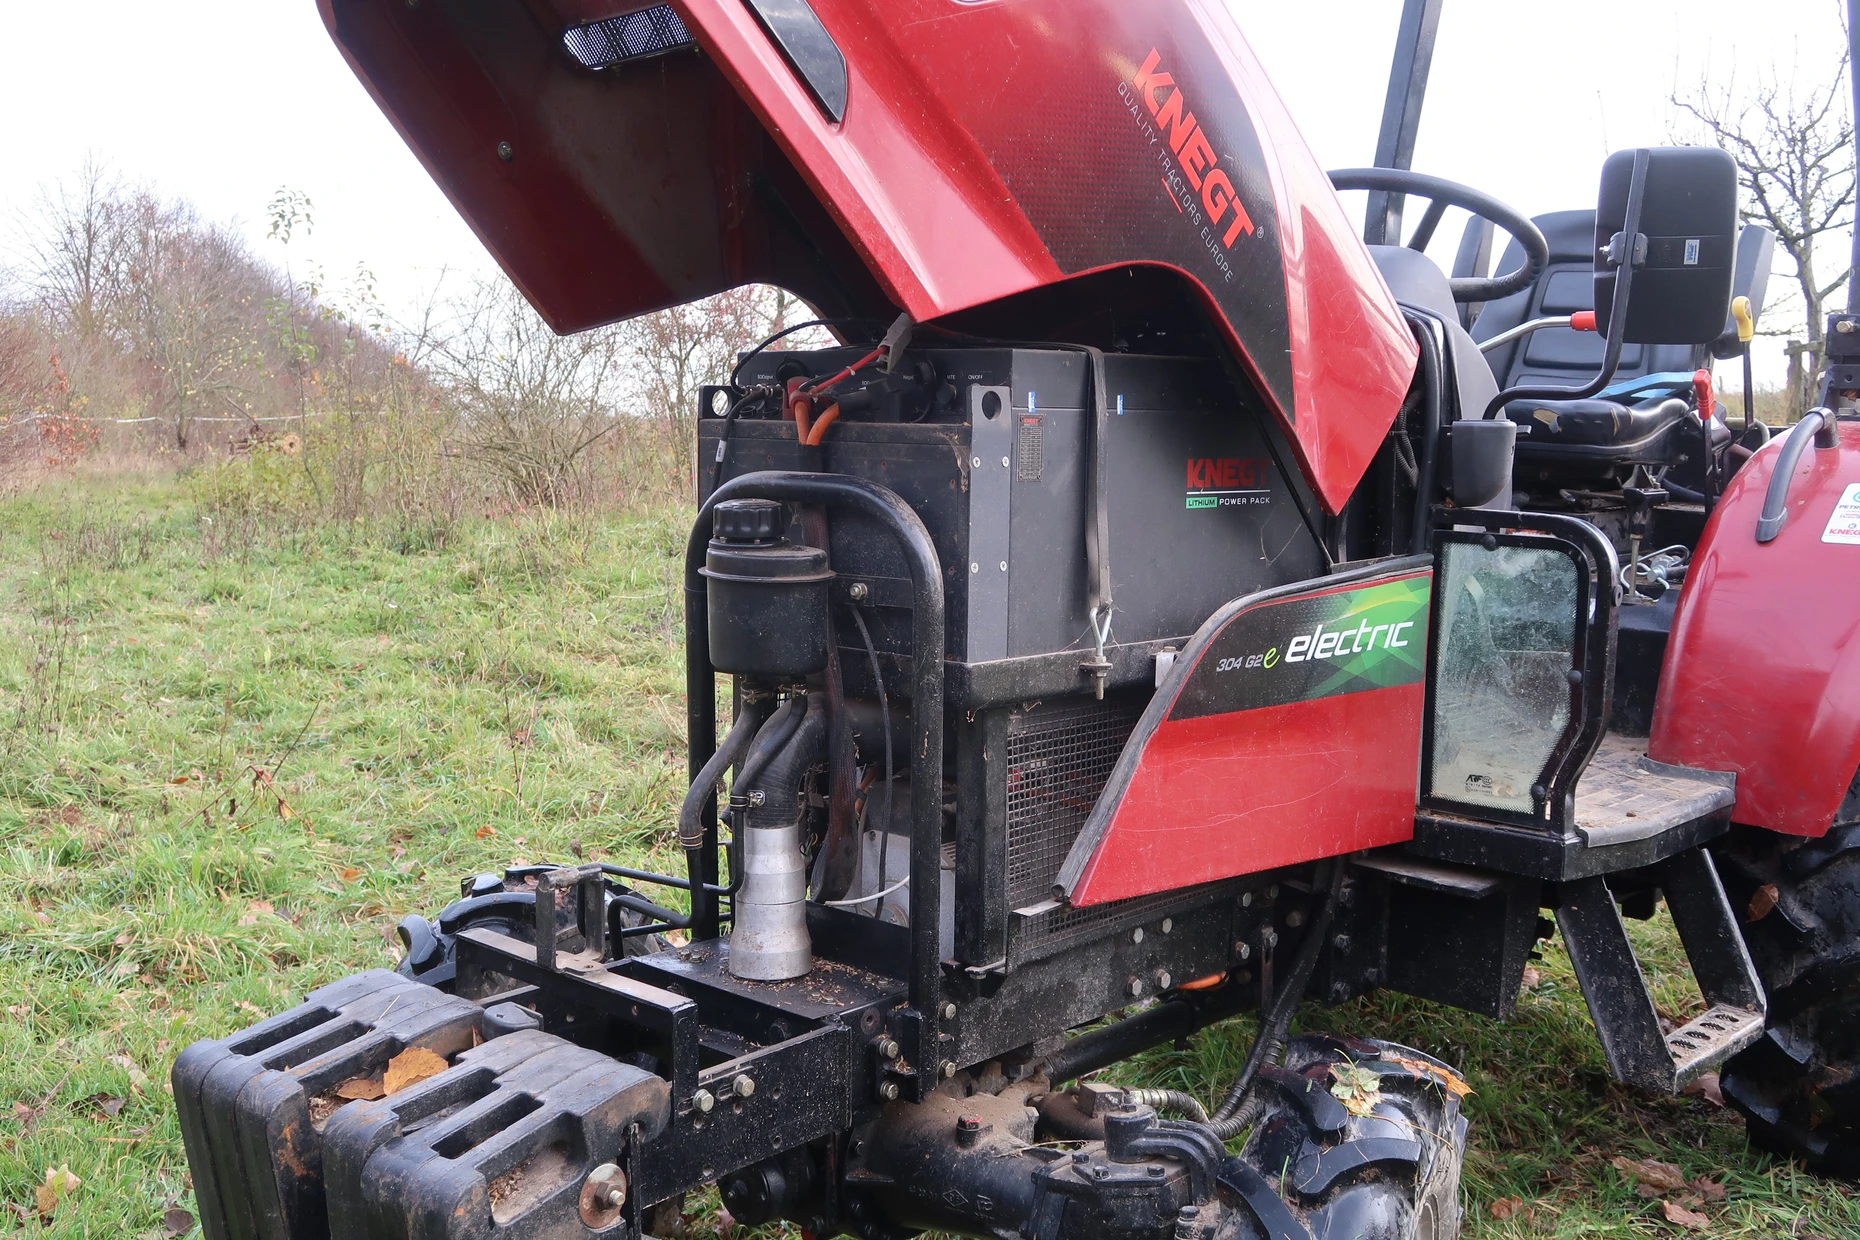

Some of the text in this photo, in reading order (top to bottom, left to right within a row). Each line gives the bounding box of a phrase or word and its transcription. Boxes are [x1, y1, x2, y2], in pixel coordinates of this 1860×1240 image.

[1132, 47, 1255, 249] KNEGT
[1117, 81, 1233, 283] QUALITY TRACTORS EUROPE
[1186, 458, 1270, 489] KNEGT
[1188, 498, 1215, 507] LITHIUM
[1219, 497, 1247, 506] POWER
[1284, 618, 1414, 663] electric
[1216, 656, 1243, 672] 304
